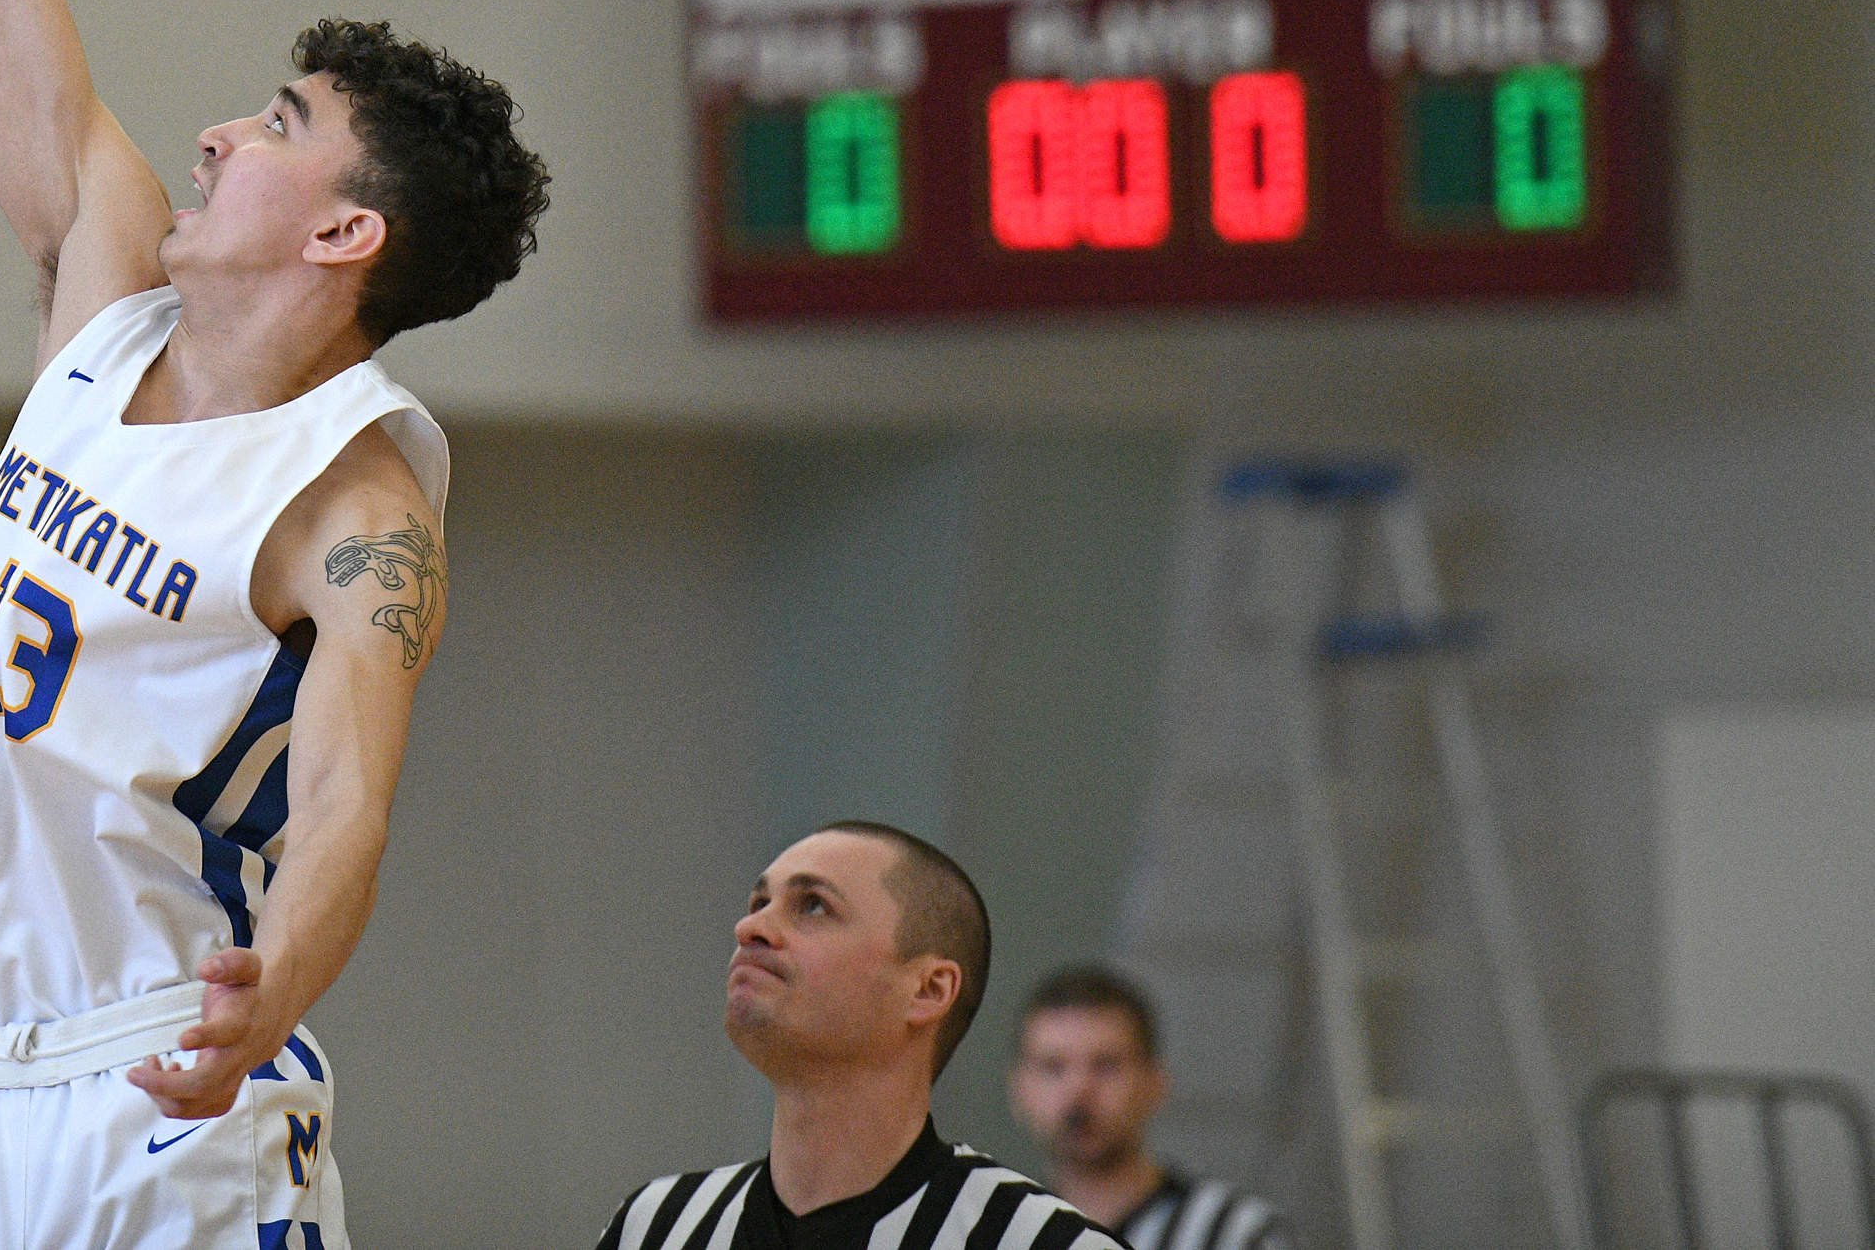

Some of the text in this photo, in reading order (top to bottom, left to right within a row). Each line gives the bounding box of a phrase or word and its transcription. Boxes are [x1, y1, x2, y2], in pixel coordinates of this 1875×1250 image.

[805, 89, 901, 256] 0
[1494, 63, 1586, 231] 0
[284, 1110, 323, 1191] M
